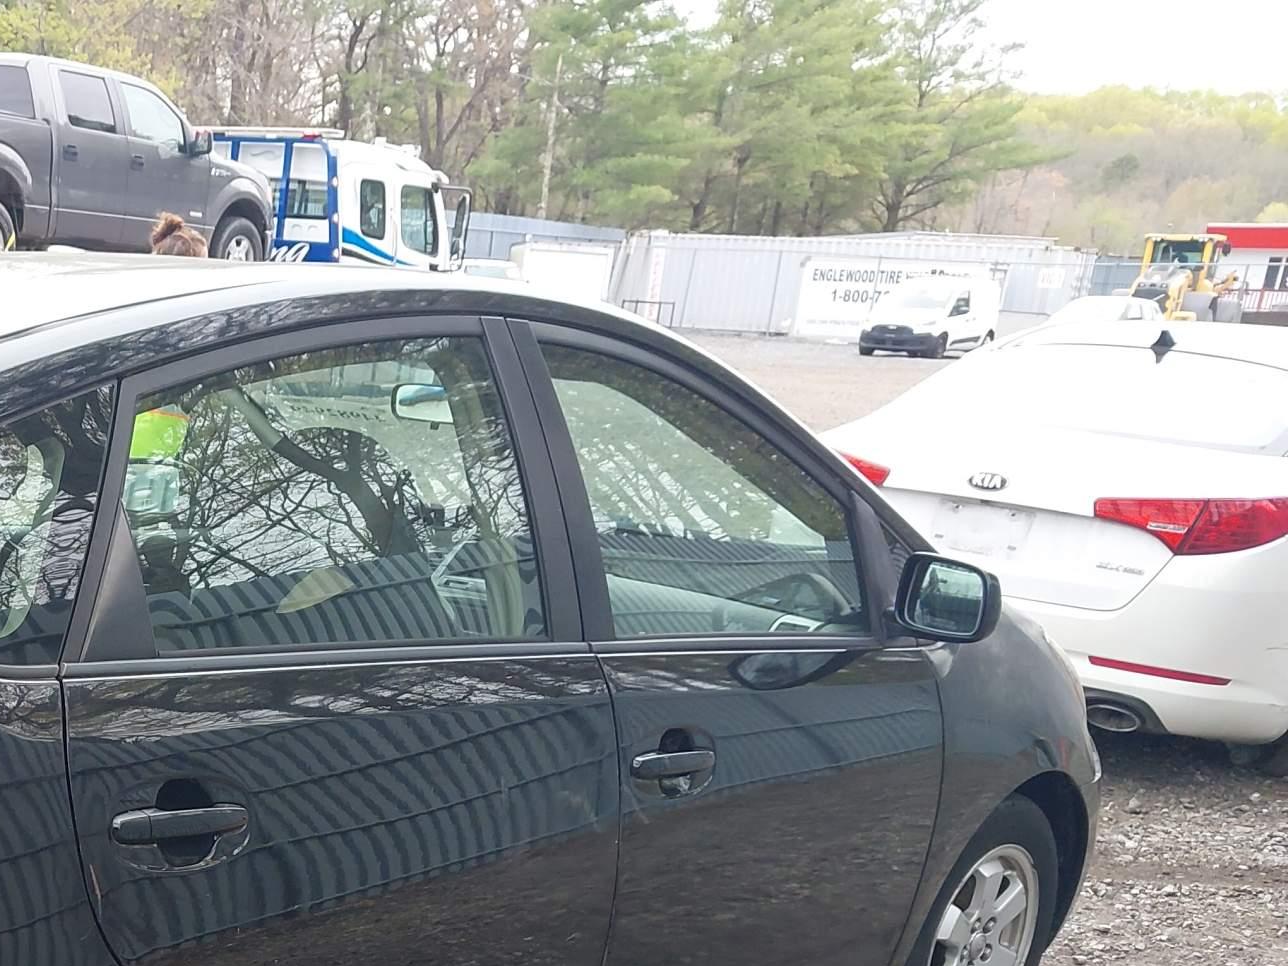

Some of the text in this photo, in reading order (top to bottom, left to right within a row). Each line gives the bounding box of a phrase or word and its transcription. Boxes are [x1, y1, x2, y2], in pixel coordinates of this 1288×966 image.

[812, 268, 876, 283] ENGLEWOOD
[879, 270, 903, 284] TIRE
[831, 288, 890, 304] 1-800-7
[970, 472, 1004, 490] KIA
